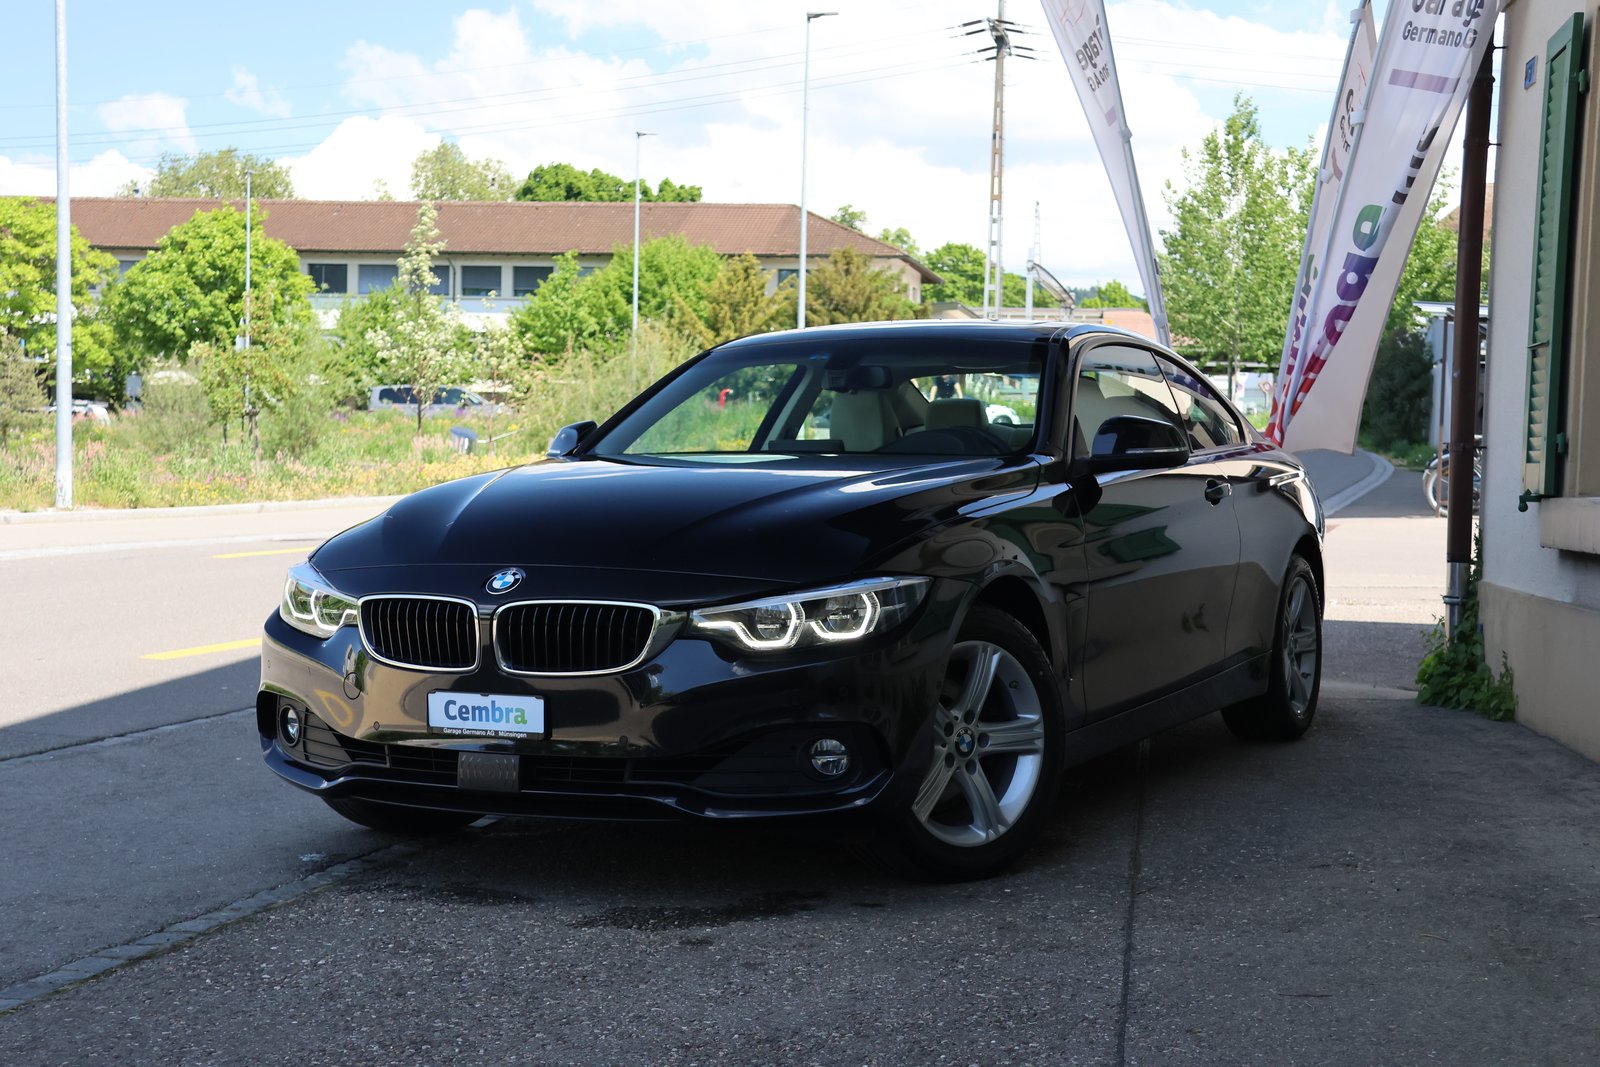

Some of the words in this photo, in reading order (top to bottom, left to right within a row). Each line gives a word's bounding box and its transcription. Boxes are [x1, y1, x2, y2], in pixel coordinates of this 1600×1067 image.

[1402, 20, 1463, 48] Germano
[444, 699, 528, 725] Cembra
[443, 727, 462, 736] Garage
[462, 728, 486, 736] Germano
[498, 730, 528, 739] Münsingen
